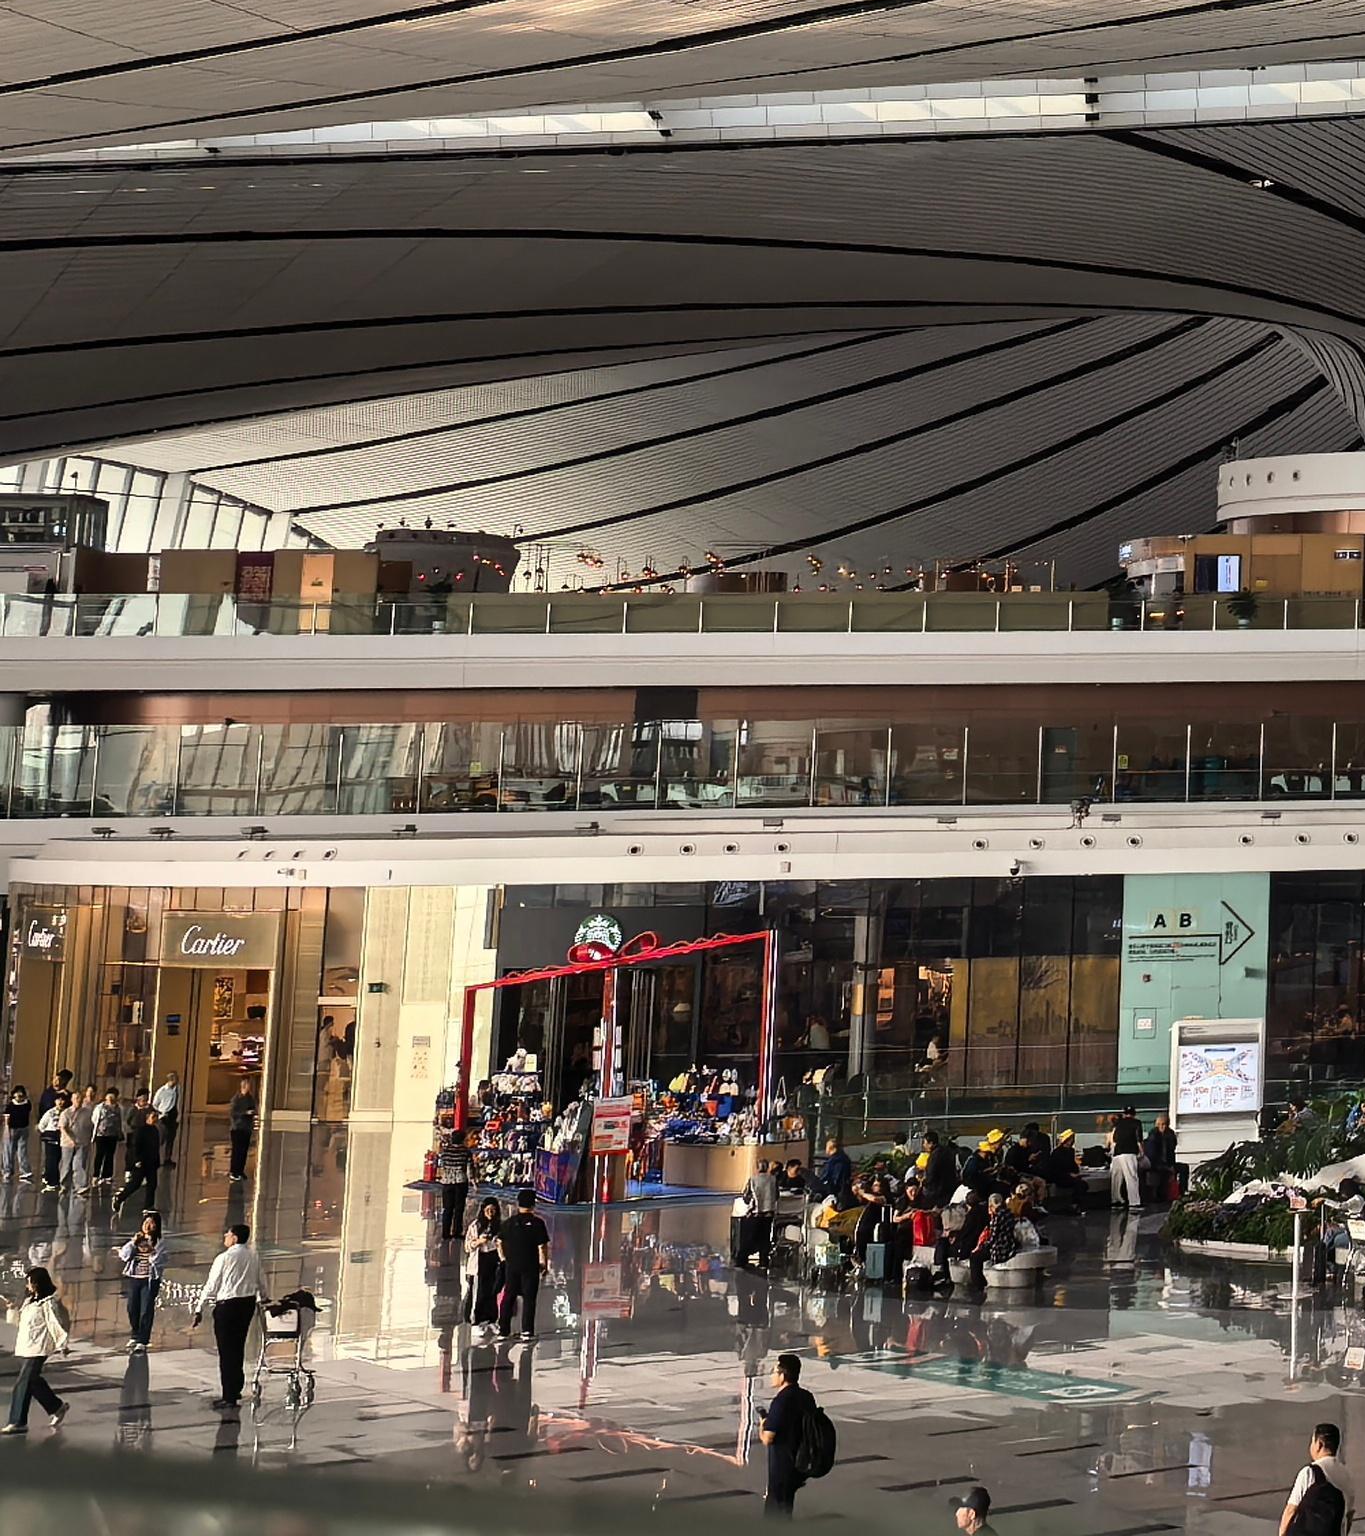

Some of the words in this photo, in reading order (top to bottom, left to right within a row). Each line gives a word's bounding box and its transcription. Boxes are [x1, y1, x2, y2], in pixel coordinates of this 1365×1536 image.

[28, 920, 54, 947] Cartier
[1154, 914, 1167, 929] A
[1179, 913, 1192, 928] B
[181, 925, 245, 955] Cartier
